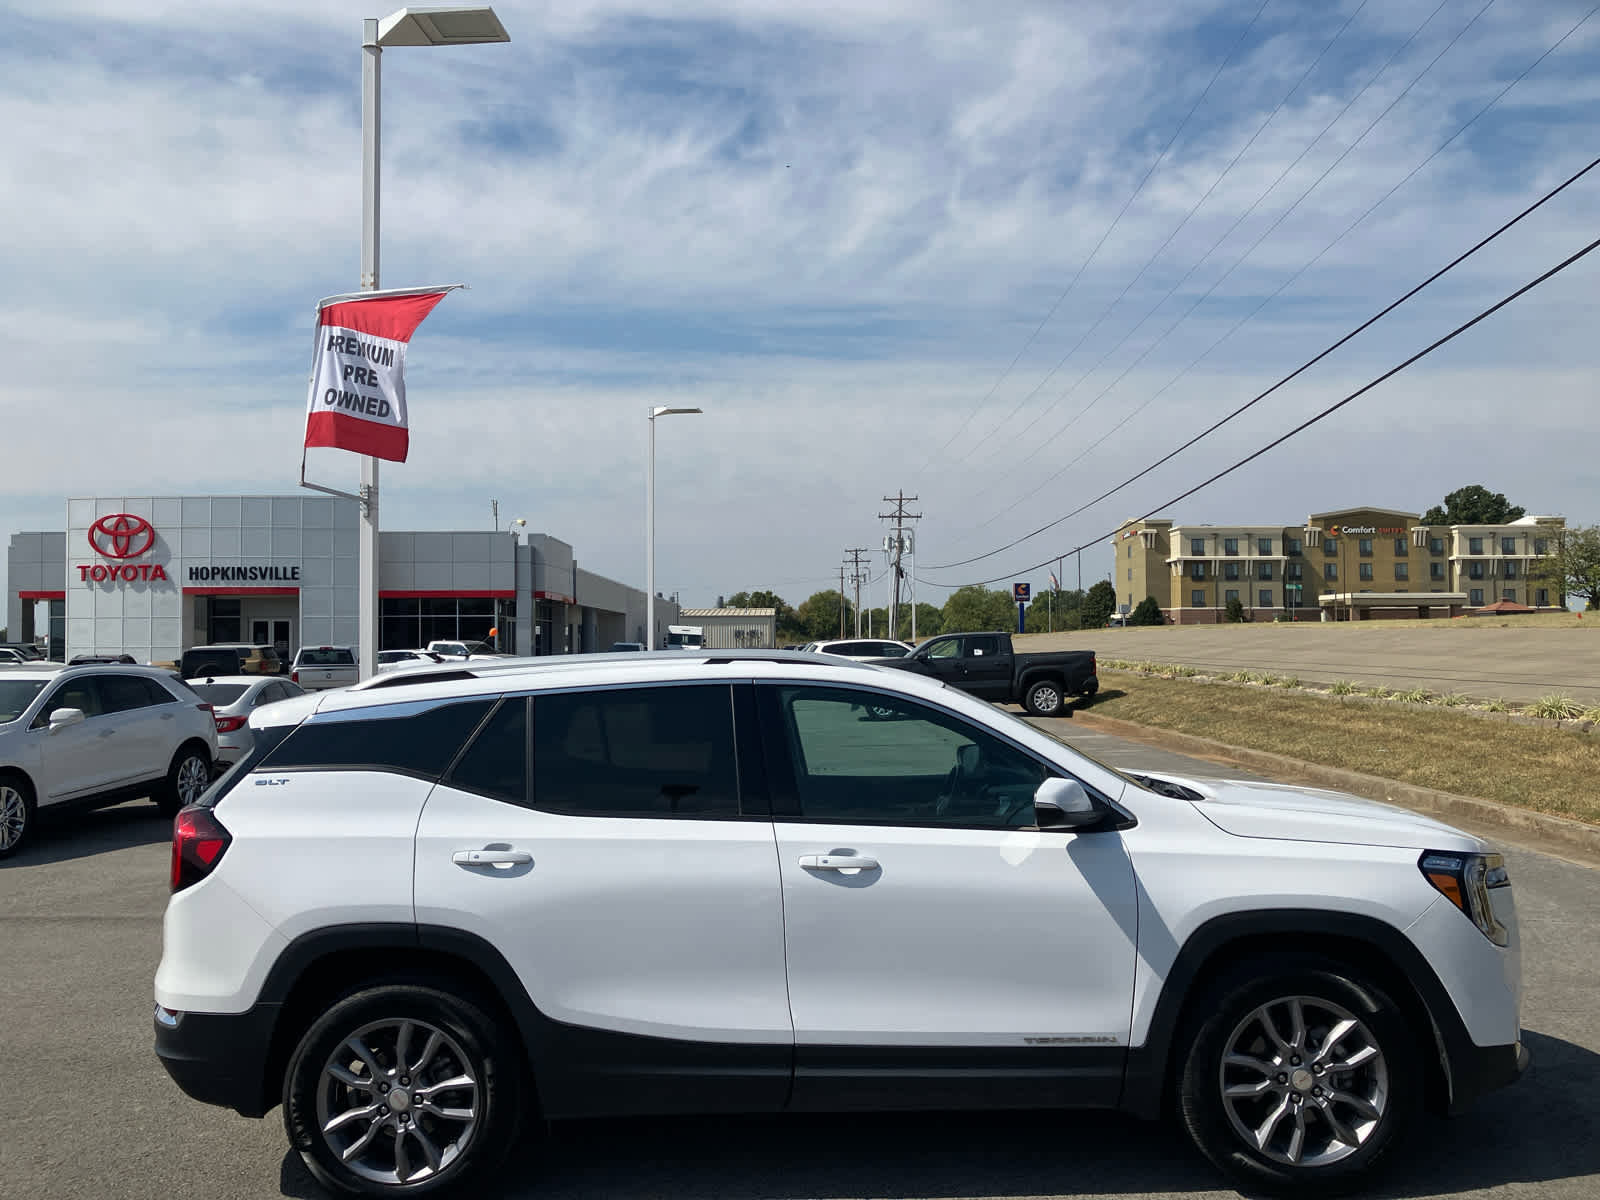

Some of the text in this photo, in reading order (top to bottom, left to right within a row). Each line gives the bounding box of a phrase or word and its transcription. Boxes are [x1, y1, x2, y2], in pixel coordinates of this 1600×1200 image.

[327, 335, 394, 368] PREMIUM
[344, 365, 378, 388] PRE
[325, 388, 390, 418] OWNED
[1342, 526, 1376, 534] Comfort
[77, 564, 167, 582] TOYOTA
[189, 566, 300, 581] HOPKINSVILLE
